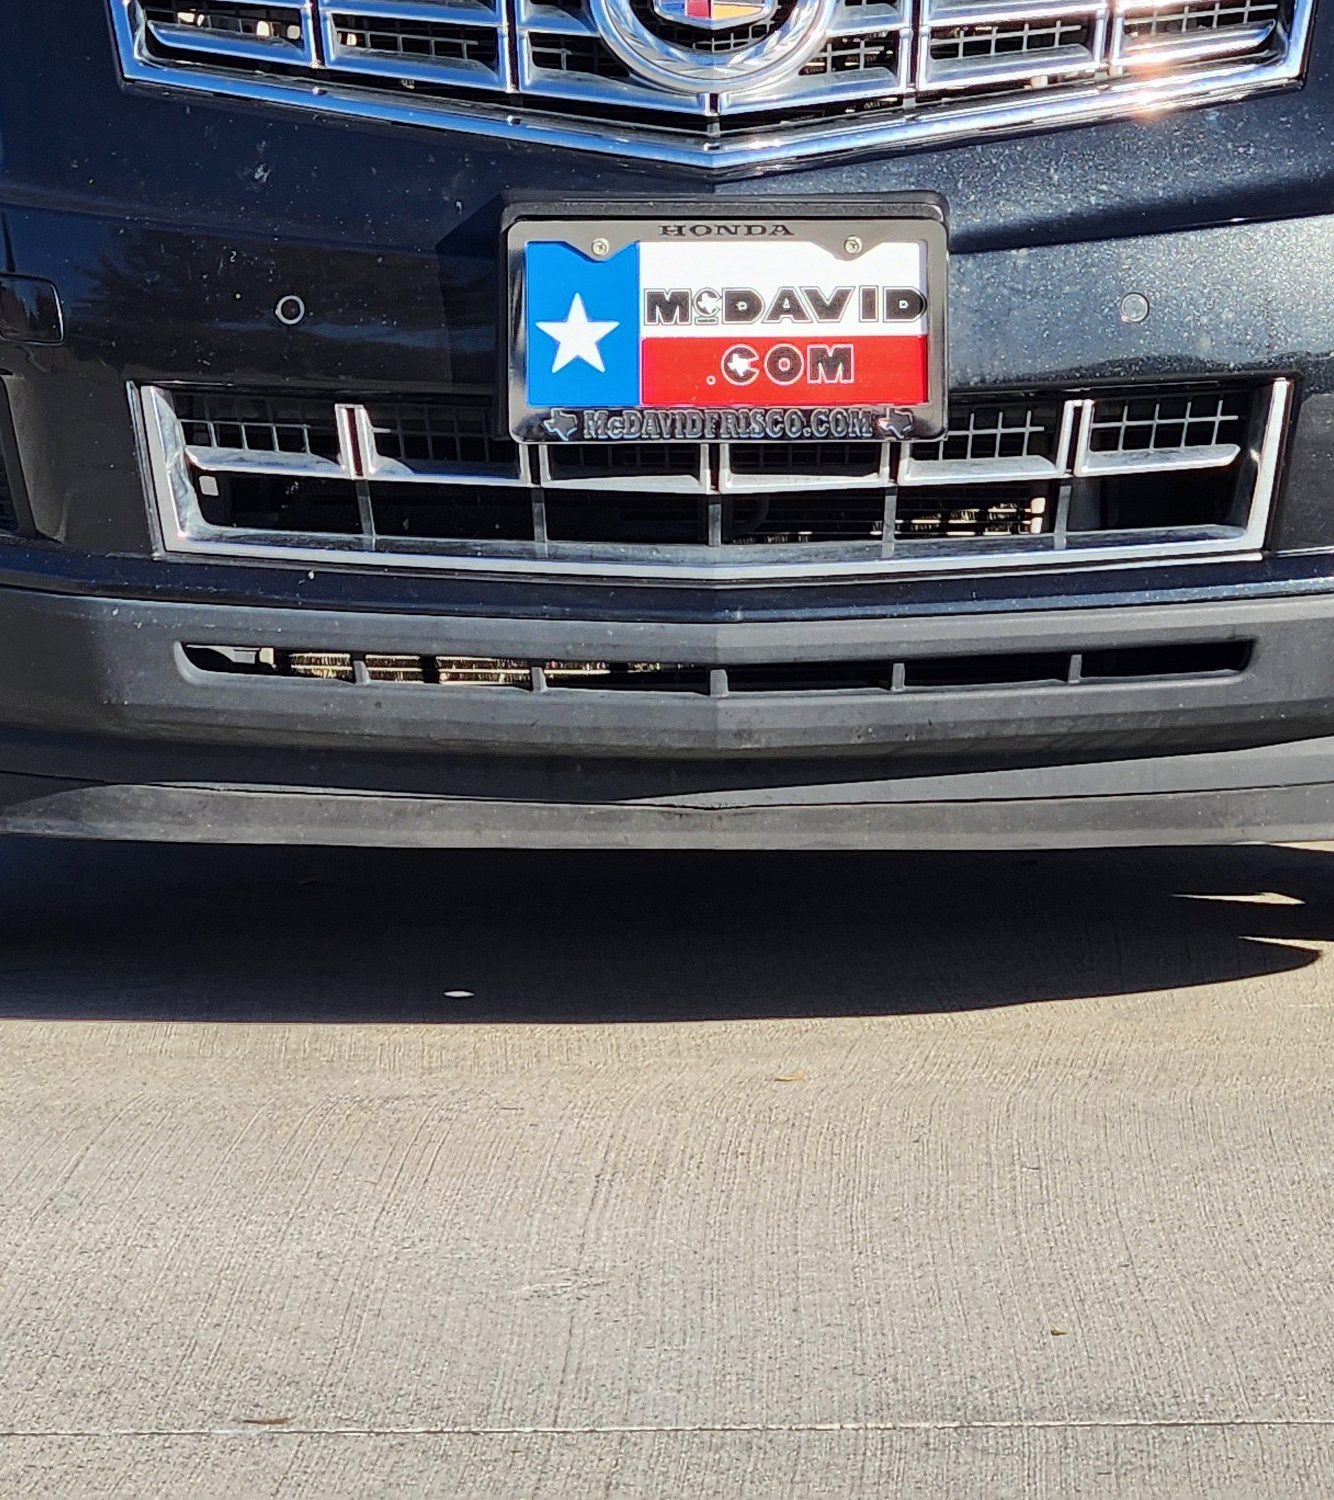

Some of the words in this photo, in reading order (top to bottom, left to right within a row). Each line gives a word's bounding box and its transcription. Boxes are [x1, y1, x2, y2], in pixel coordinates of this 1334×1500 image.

[658, 224, 795, 237] HONDA
[644, 285, 928, 325] McDAVID
[706, 343, 855, 386] .COM
[583, 408, 873, 440] McDAVIDFRISCO.COM
